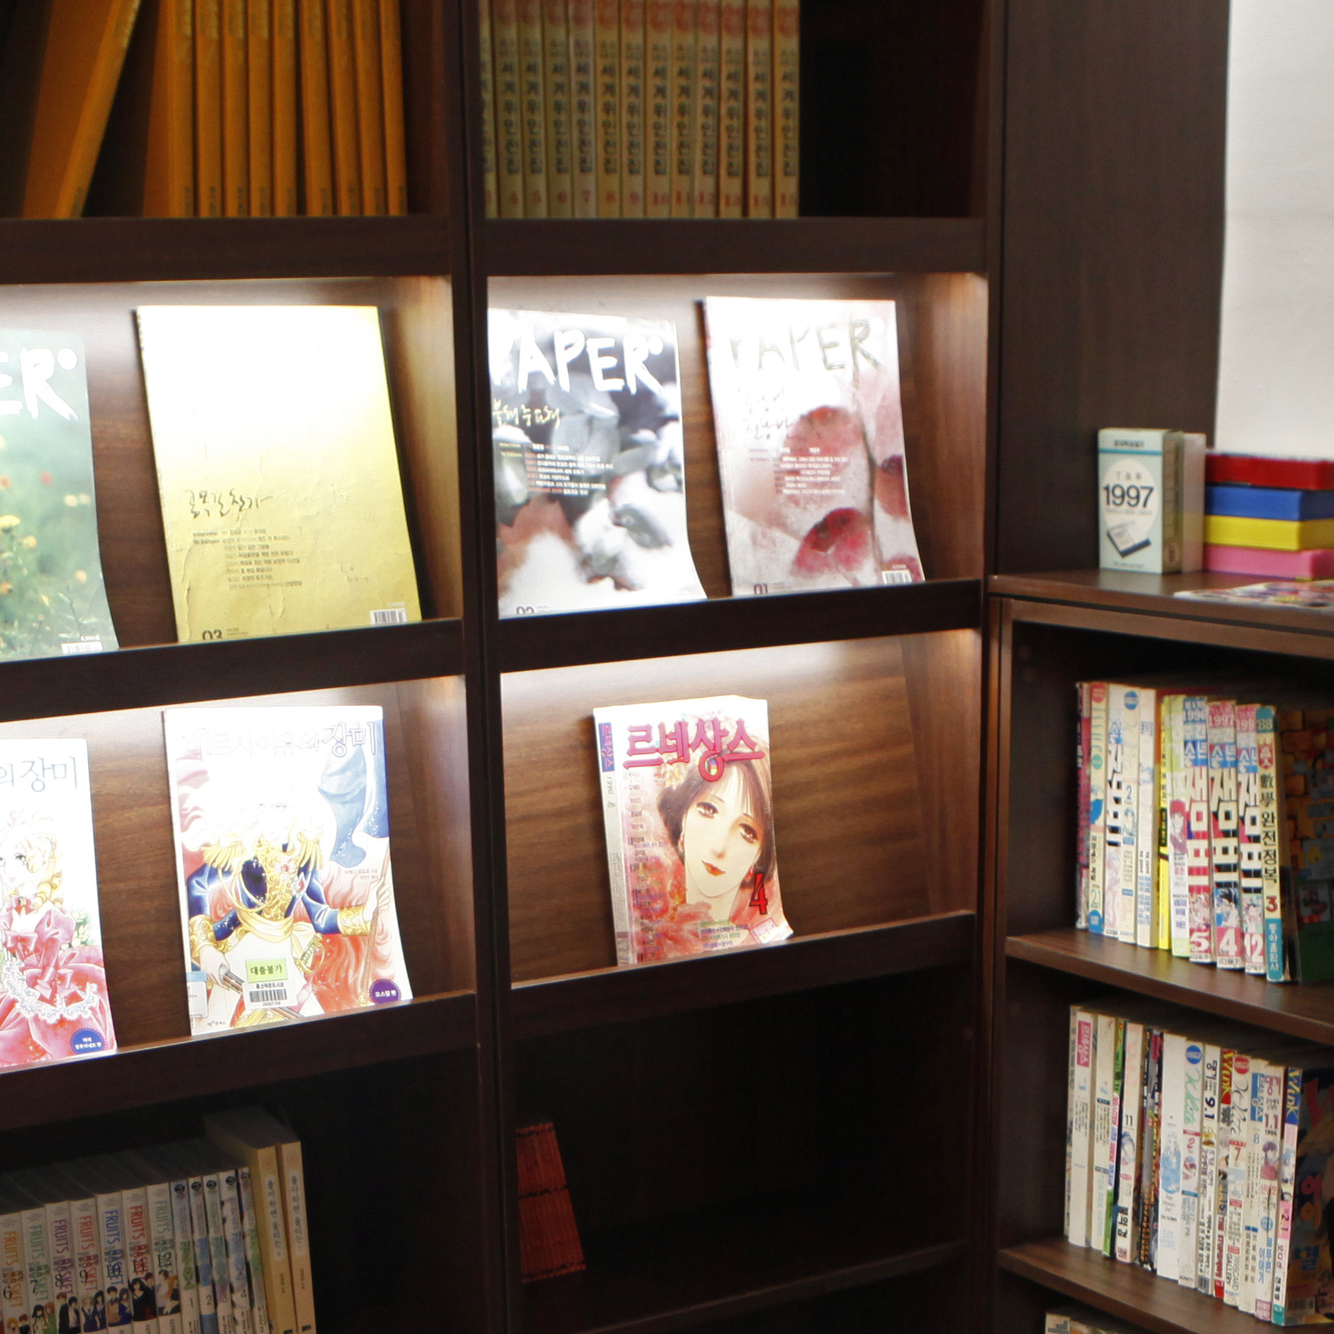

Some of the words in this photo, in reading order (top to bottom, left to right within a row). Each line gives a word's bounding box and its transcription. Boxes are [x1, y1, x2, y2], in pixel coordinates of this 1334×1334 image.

[489, 325, 667, 397] PAPER
[729, 318, 885, 374] PAPER
[1102, 484, 1155, 508] 1997
[322, 721, 376, 758] 장미
[623, 717, 765, 782] 르네상스
[20, 756, 79, 793] 장미
[749, 872, 768, 915] 4
[1265, 895, 1278, 913] 3
[1191, 932, 1209, 949] 5
[1220, 929, 1238, 957] 4
[1244, 933, 1264, 963] 12
[250, 964, 284, 976] 대출불가
[1286, 1068, 1301, 1123] Wink
[1187, 1138, 1195, 1149] 2
[79, 1215, 94, 1250] FRUITS
[155, 1201, 170, 1236] FRUITS
[4, 1231, 19, 1267] FRUITS
[30, 1225, 45, 1259] FRUITS
[54, 1219, 69, 1254] FRUITS
